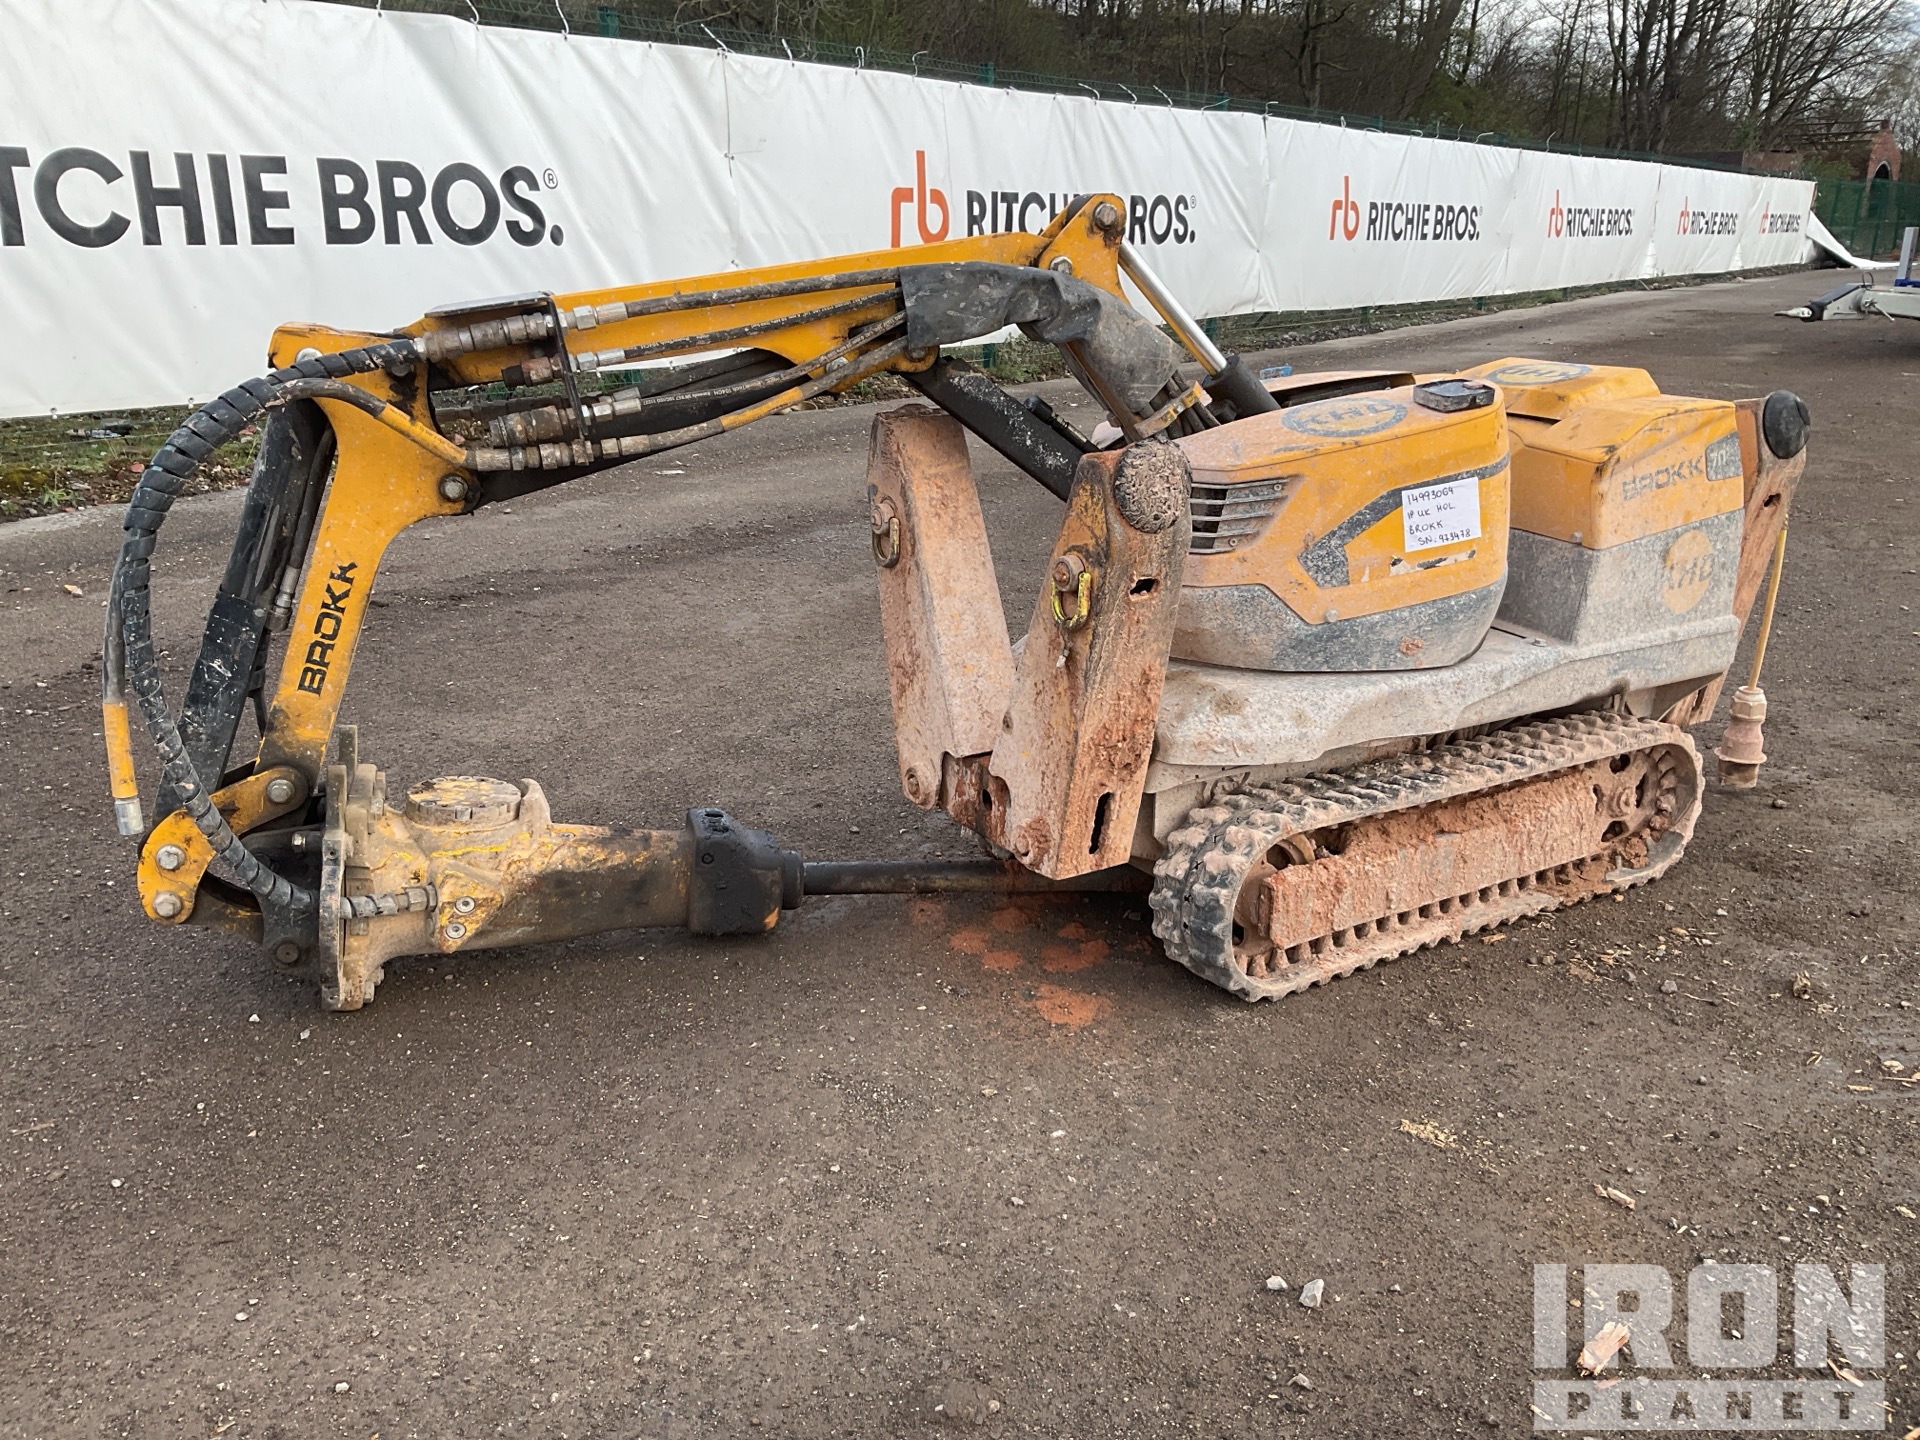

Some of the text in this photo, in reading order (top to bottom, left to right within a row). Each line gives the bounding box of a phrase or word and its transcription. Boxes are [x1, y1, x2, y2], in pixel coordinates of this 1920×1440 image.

[1128, 194, 1196, 245] ROS.
[1366, 201, 1431, 241] RITCHIE
[1566, 207, 1606, 237] RITCHIE
[1409, 519, 1443, 535] BROKK
[296, 561, 358, 697] BROKK
